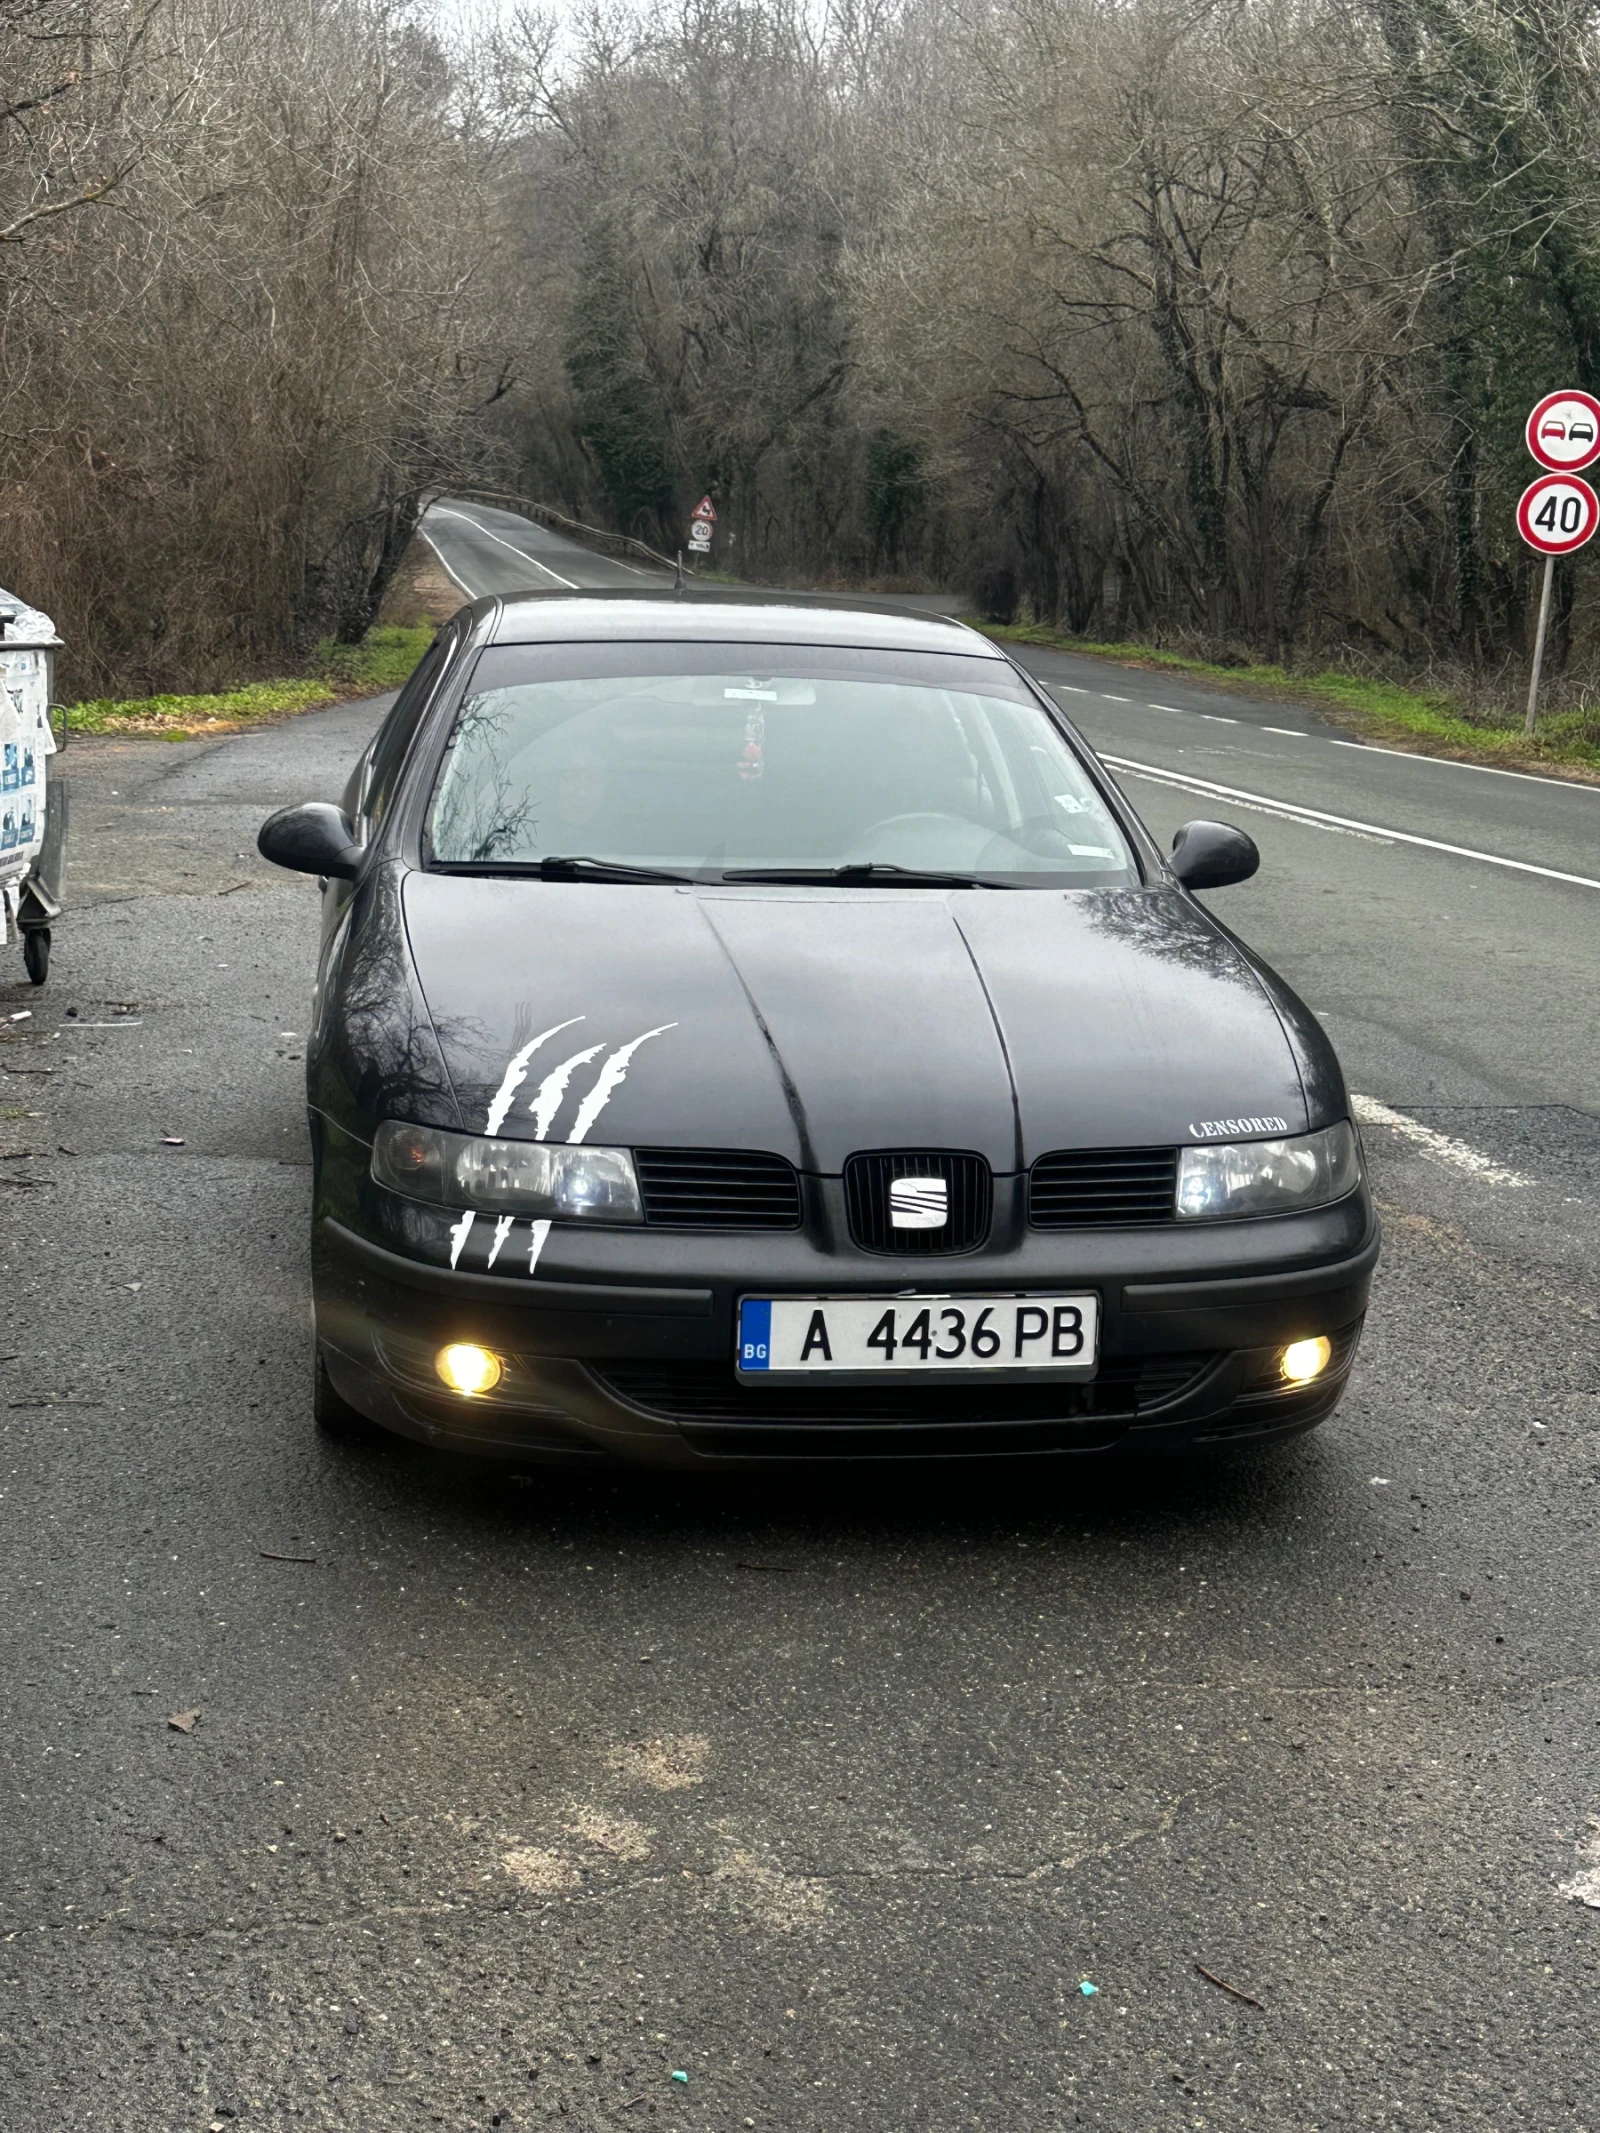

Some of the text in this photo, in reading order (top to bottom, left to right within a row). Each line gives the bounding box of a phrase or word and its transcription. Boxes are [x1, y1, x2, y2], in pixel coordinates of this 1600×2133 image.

[1535, 496, 1581, 533] 40
[695, 525, 708, 535] 20
[1189, 1117, 1288, 1138] CENSORED
[743, 1306, 1084, 1361] BG A 4436 PB
